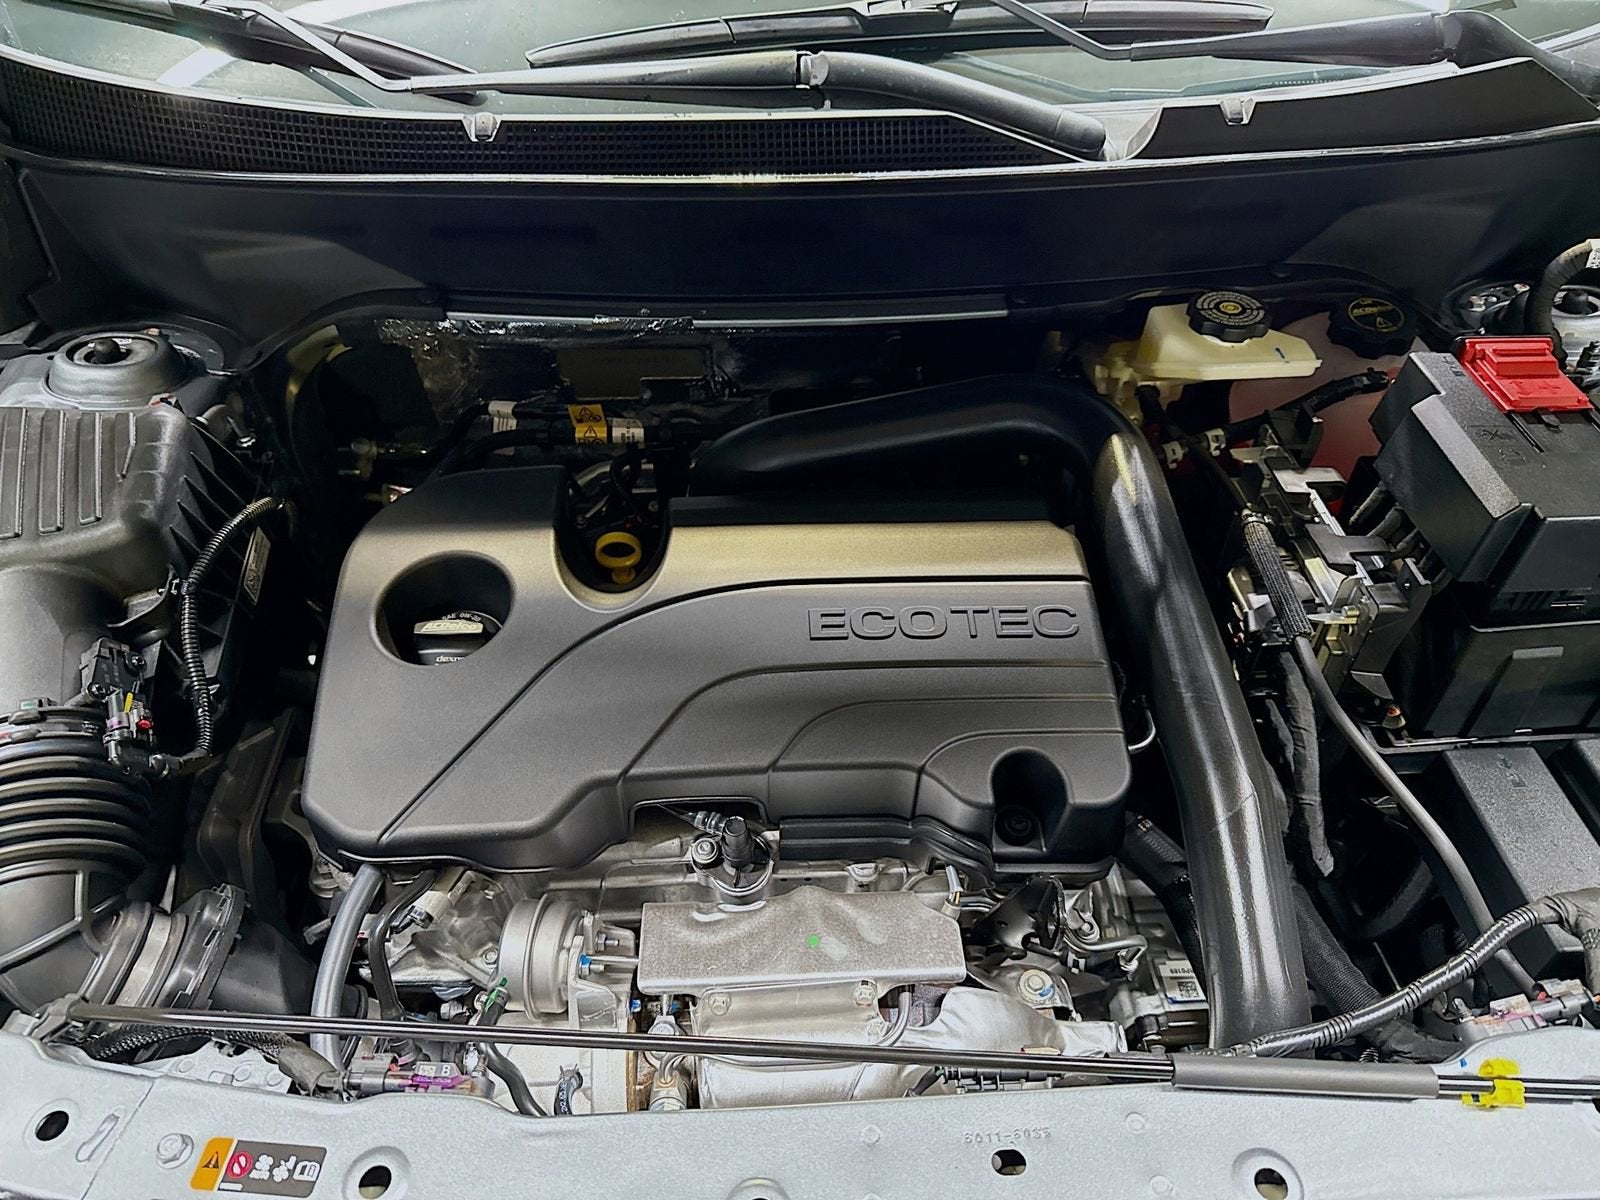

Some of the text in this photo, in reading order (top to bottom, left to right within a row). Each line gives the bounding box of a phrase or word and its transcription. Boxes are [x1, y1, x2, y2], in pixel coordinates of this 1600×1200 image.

[442, 612, 456, 621] SAE
[421, 621, 478, 632] ACDelco
[808, 605, 1079, 640] ECOTEC
[441, 1064, 451, 1075] B
